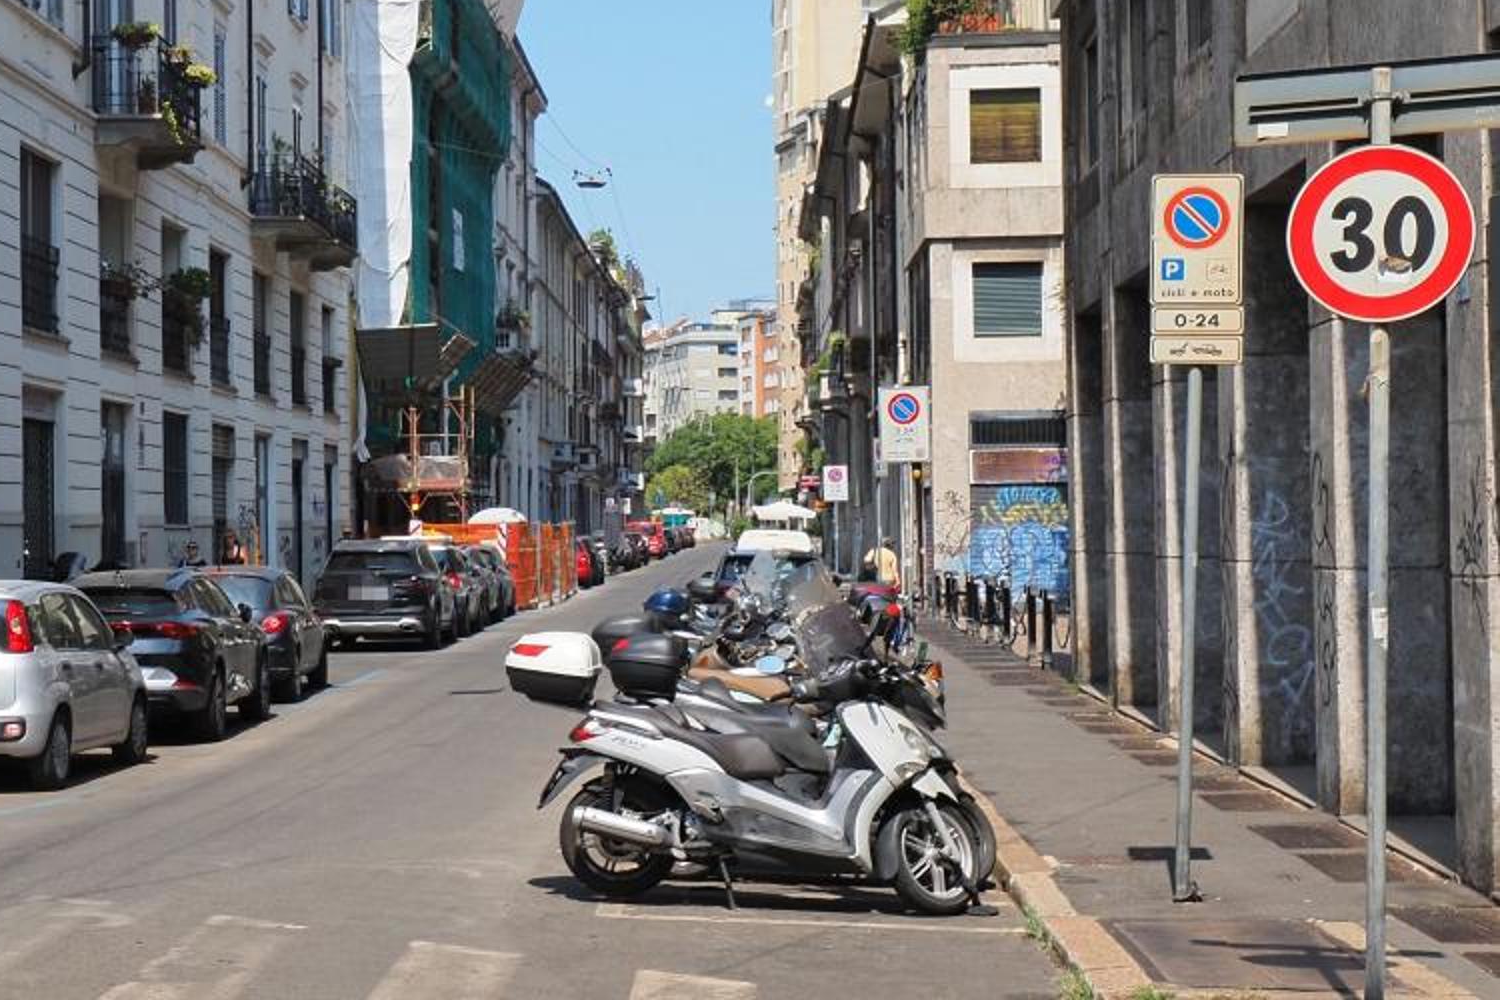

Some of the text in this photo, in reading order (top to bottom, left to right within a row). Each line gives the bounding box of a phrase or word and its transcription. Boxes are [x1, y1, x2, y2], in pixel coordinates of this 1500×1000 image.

[1330, 195, 1436, 274] 30
[1165, 261, 1179, 278] P
[1203, 288, 1235, 298] moto
[1174, 313, 1220, 328] 0-24
